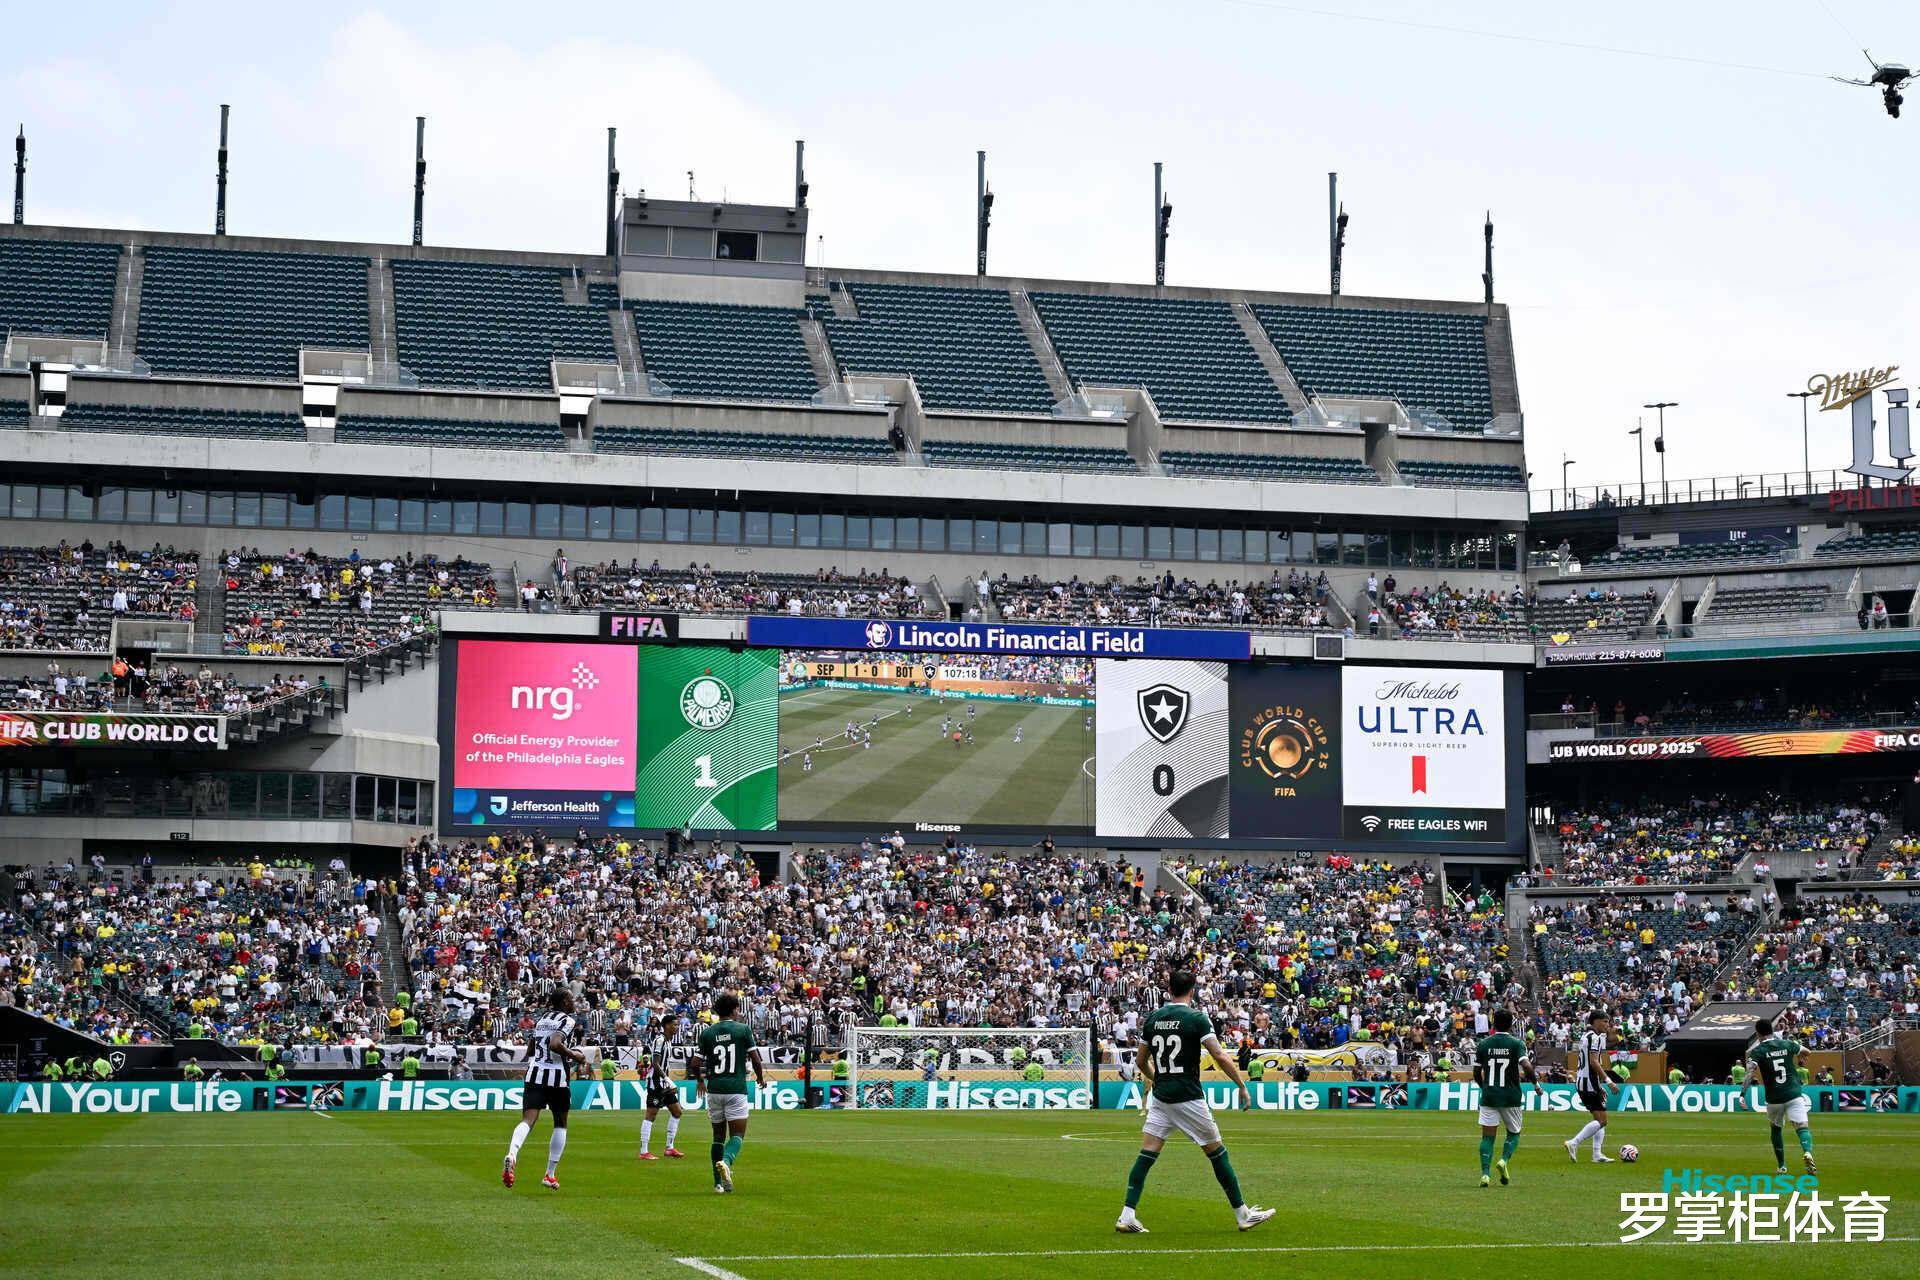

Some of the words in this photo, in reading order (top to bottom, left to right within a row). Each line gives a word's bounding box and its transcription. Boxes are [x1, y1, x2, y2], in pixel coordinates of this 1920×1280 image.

[1807, 365, 1899, 407] Miller
[1843, 388, 1920, 482] Li
[1729, 530, 1747, 541] Lite
[611, 616, 668, 638] FIFA
[899, 625, 980, 648] Lincoln
[986, 628, 1086, 651] Financial
[1092, 631, 1144, 653] Field
[1599, 649, 1661, 660] 215-874-6008
[816, 663, 834, 676] SEP
[854, 665, 859, 676] 1
[895, 666, 914, 678] BOT
[944, 668, 977, 679] 107:18
[511, 685, 573, 720] nrg
[1375, 680, 1461, 700] Michelob
[683, 699, 731, 727] PALMEIRAS
[1358, 705, 1485, 736] ULTRA
[43, 722, 102, 740] CLUB
[106, 724, 188, 742] WORLD
[472, 733, 517, 745] Official
[520, 734, 564, 748] Energy
[567, 735, 620, 747] Provider
[1241, 728, 1254, 768] CLUB
[1253, 705, 1304, 725] WORLD
[1307, 718, 1328, 745] CUP
[1318, 752, 1329, 769] 25
[1874, 734, 1907, 747] FIFA
[1909, 734, 1920, 746] C
[466, 751, 479, 762] of
[482, 752, 504, 762] the
[506, 752, 582, 766] Philadelphia
[585, 754, 625, 767] Eagles
[1576, 744, 1626, 757] WORLD
[1629, 743, 1657, 755] CUP
[694, 754, 717, 787] 1
[1152, 763, 1175, 797] 0
[1274, 787, 1296, 796] FIFA
[511, 800, 562, 812] Jefferson
[563, 801, 600, 813] Health
[915, 822, 961, 833] Hisense
[1388, 819, 1415, 830] FREE
[1418, 819, 1461, 831] EAGLES
[1464, 820, 1488, 831] WIFI
[534, 1036, 553, 1064] 31
[713, 1043, 736, 1074] 31
[1151, 1034, 1184, 1074] 22
[1487, 1058, 1510, 1087] 17
[1772, 1058, 1787, 1084] 5
[8, 1082, 51, 1112] AI
[62, 1082, 160, 1112] Your
[171, 1081, 242, 1112] Life
[378, 1080, 525, 1111] Hisens
[581, 1080, 621, 1110] AI
[927, 1081, 1093, 1109] Hisense
[1257, 1082, 1320, 1110] Life
[1618, 1083, 1648, 1112] AI
[1659, 1084, 1740, 1112] Your
